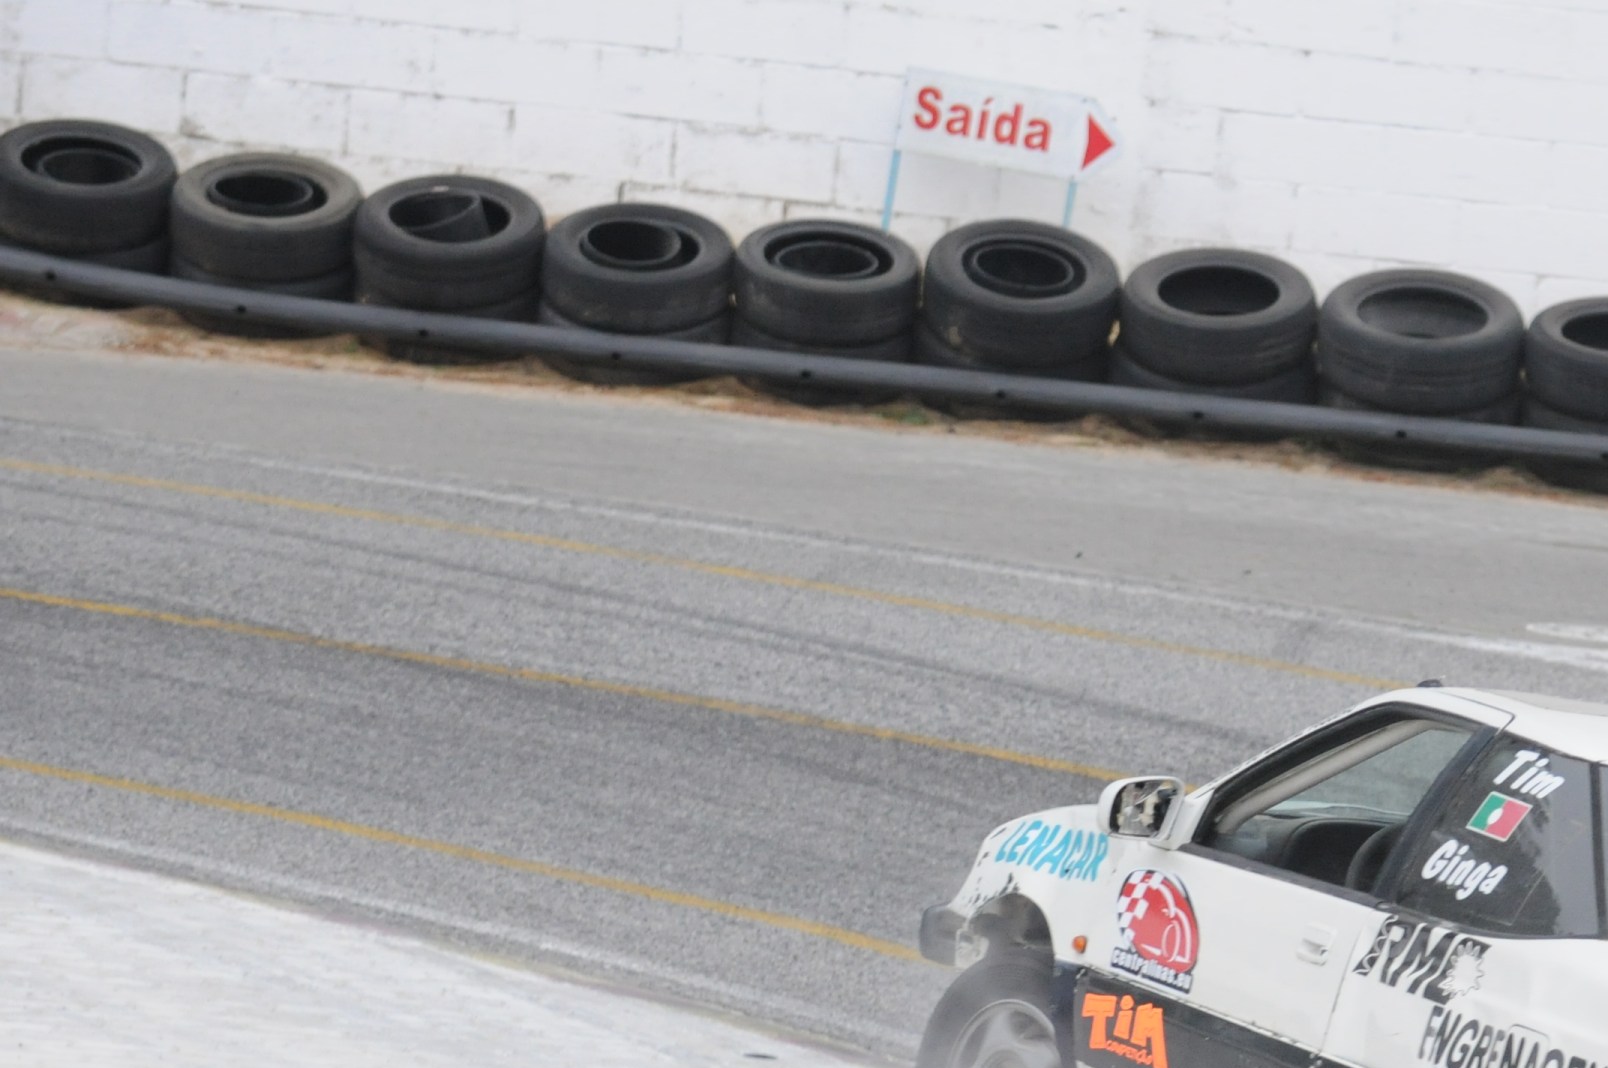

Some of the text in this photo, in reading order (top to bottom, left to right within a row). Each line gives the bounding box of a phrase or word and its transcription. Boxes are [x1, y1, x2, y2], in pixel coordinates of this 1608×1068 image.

[913, 86, 1052, 152] Saída
[1492, 749, 1565, 799] Tim
[995, 820, 1109, 882] LENACAR
[1421, 839, 1508, 901] Ginga
